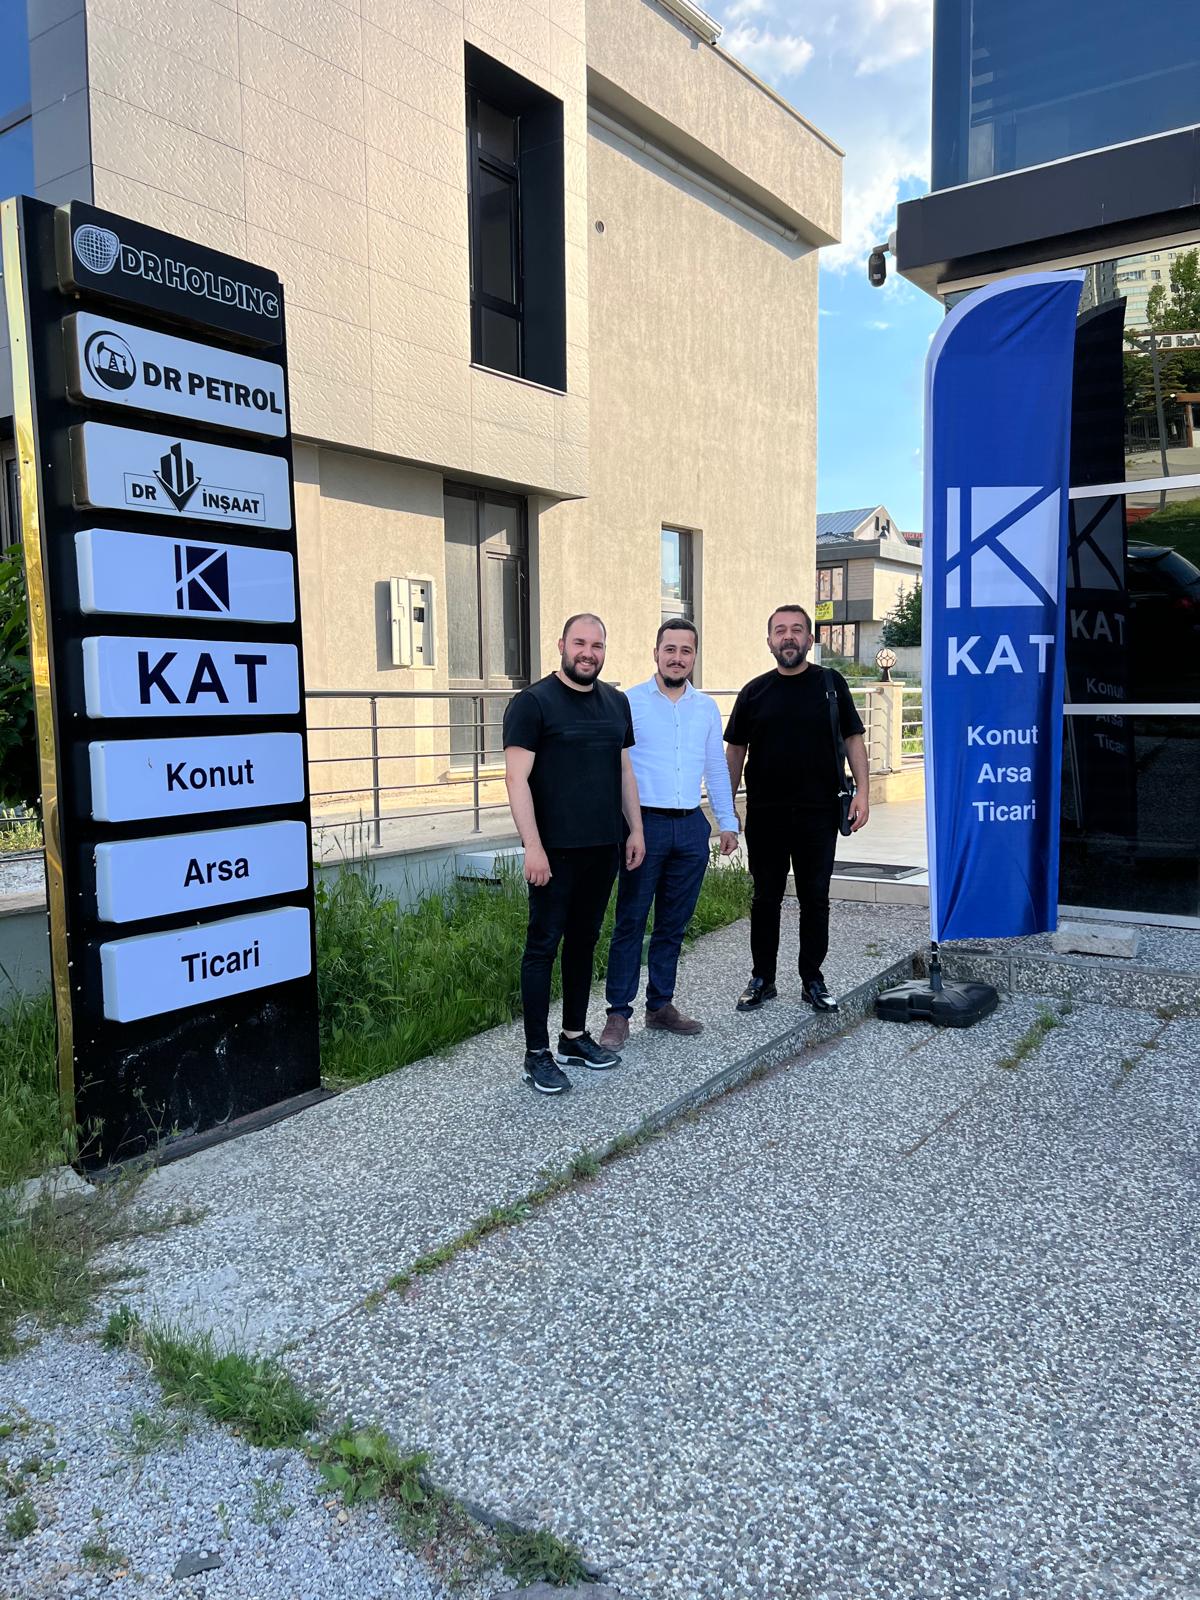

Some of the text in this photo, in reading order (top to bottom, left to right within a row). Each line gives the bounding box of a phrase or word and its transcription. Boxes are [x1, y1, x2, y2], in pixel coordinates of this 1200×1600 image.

[120, 244, 279, 319] DR HOLDING
[143, 361, 283, 414] DR PETROL
[132, 483, 260, 514] DR İNŞAAT
[1070, 609, 1125, 646] KAT
[947, 634, 1055, 676] KAT
[137, 651, 268, 705] KAT
[967, 725, 1039, 746] Konut
[166, 759, 255, 792] Konut
[977, 763, 1032, 784] Arsa
[971, 799, 1036, 822] Ticari
[184, 857, 250, 887] Arsa
[181, 940, 260, 983] Ticari
